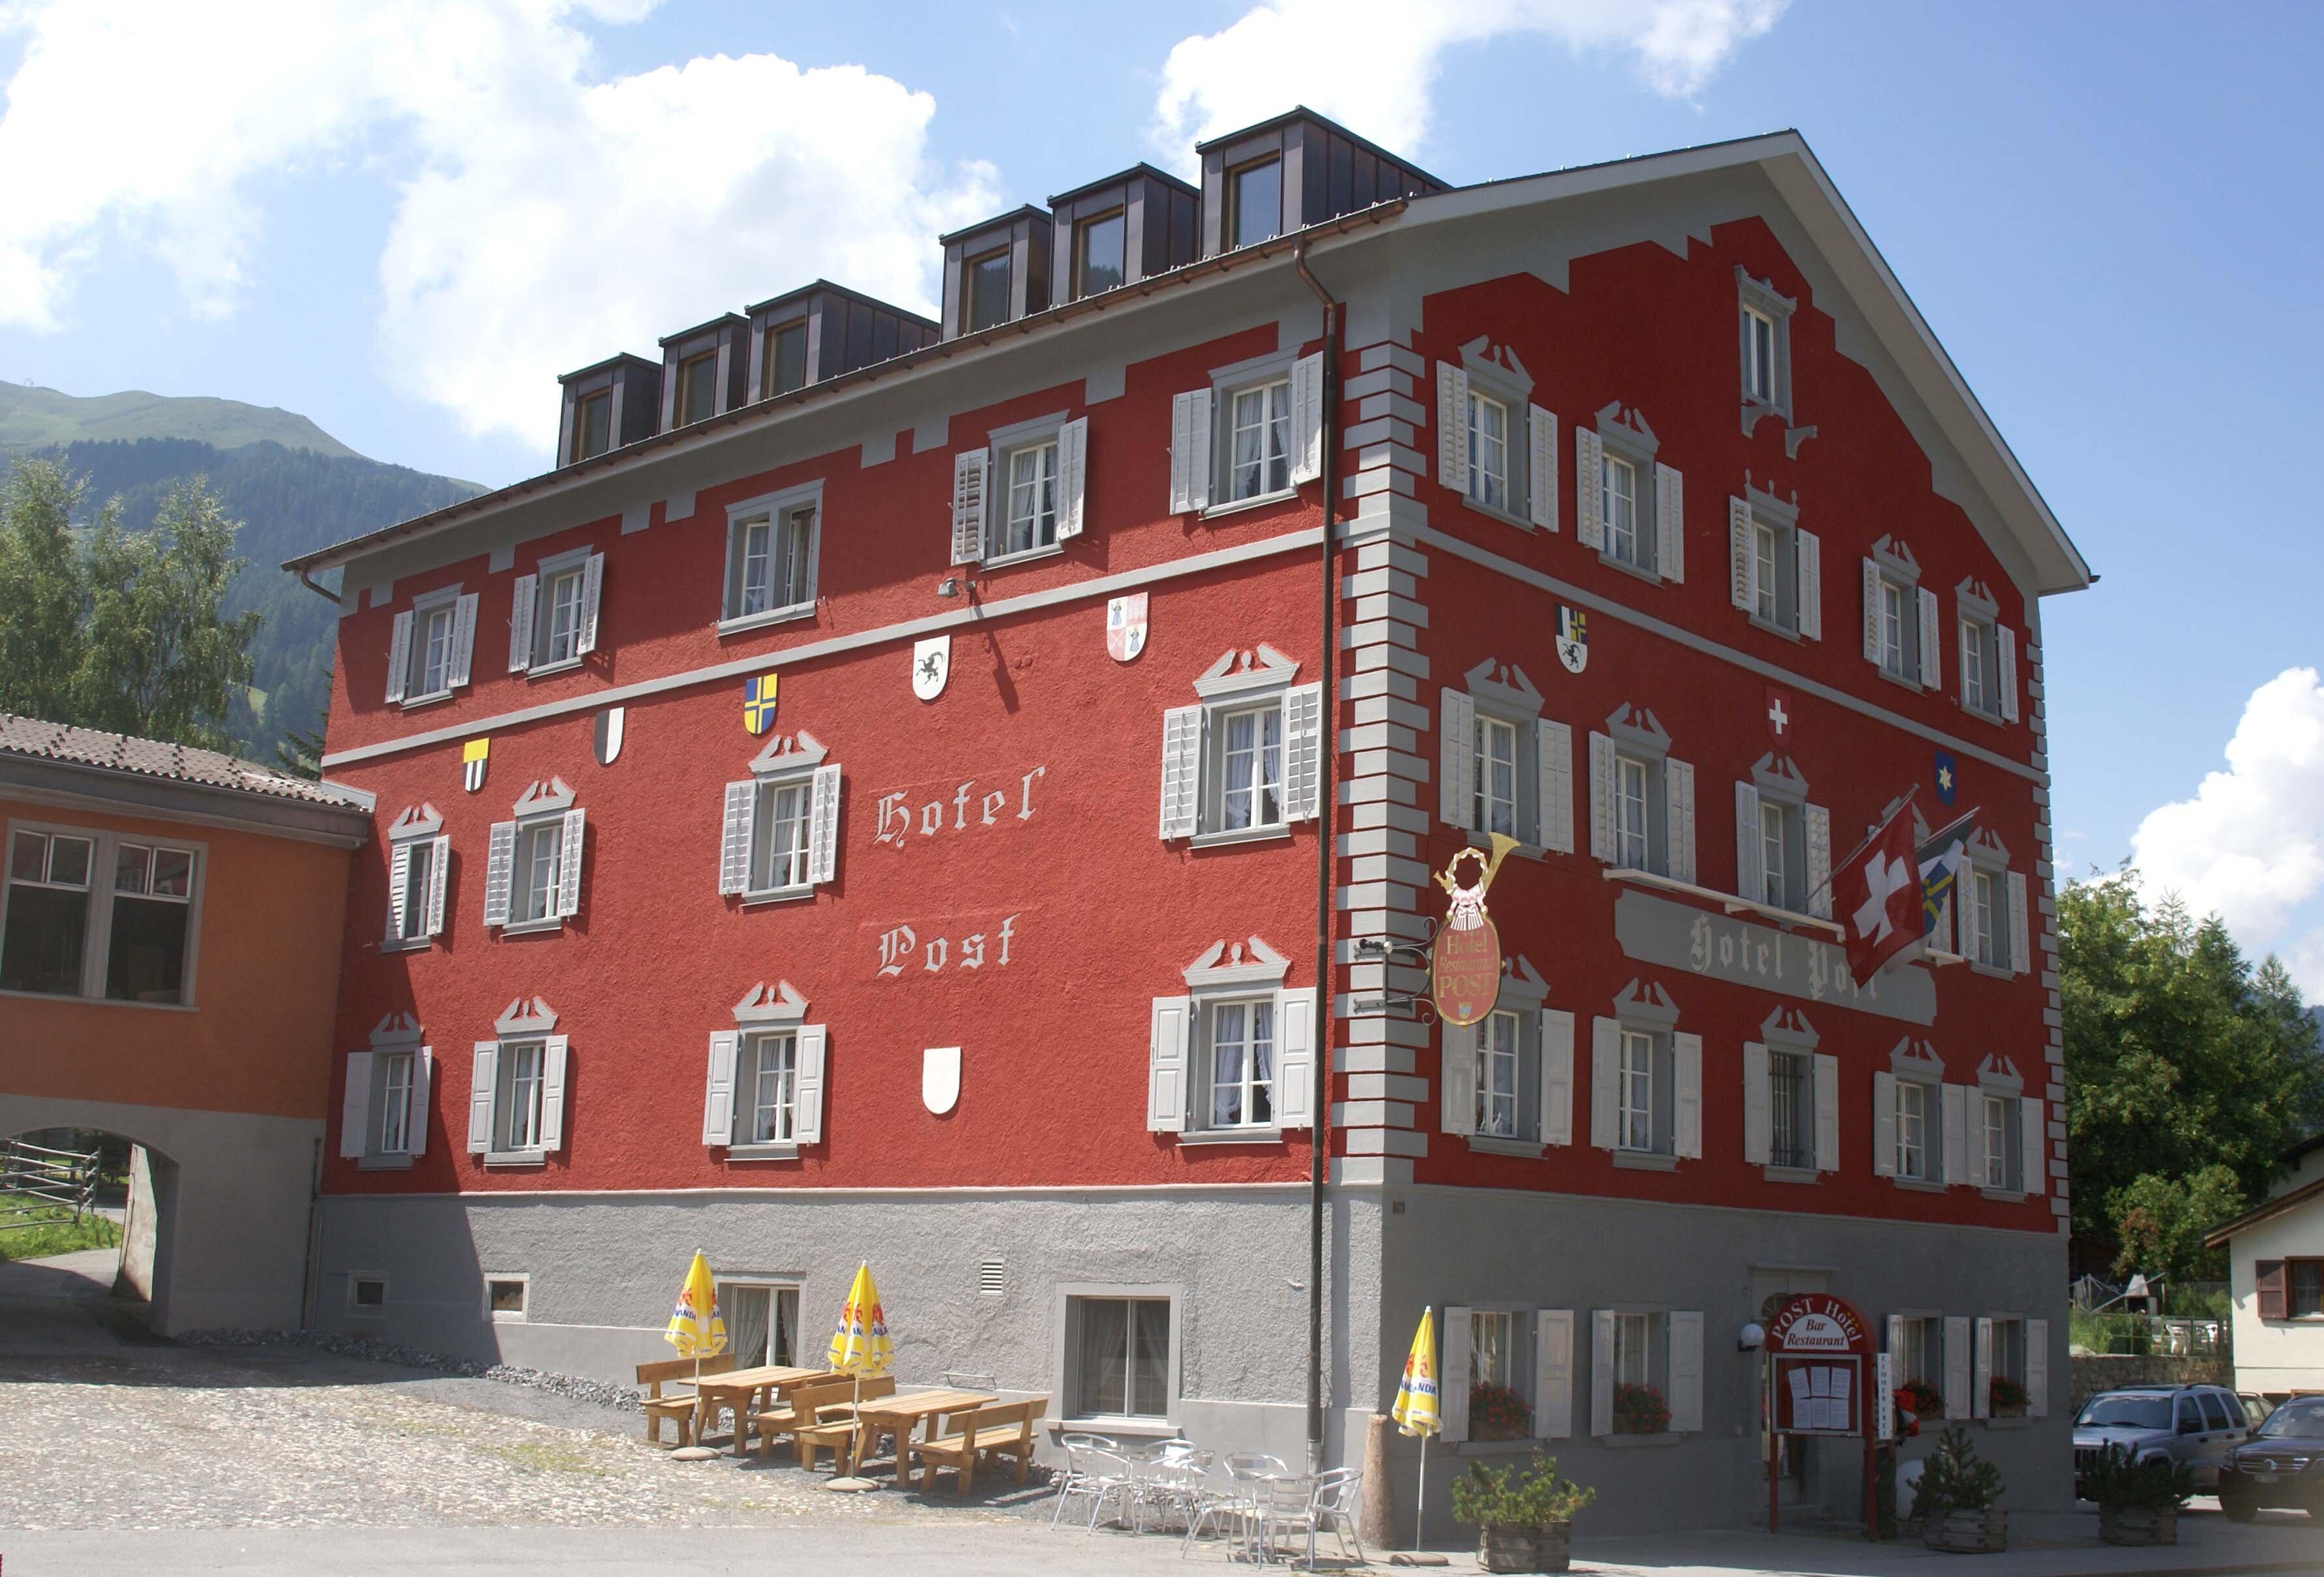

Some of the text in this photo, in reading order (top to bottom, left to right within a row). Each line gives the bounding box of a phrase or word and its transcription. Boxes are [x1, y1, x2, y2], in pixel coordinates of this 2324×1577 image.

[873, 766, 1045, 847] Hotel
[876, 912, 1021, 978] Post
[1446, 932, 1487, 954] Hotel
[1690, 912, 1783, 980] Hotel
[1438, 972, 1496, 999] POST
[1772, 1297, 1862, 1342] POST Hotel
[1805, 1319, 1826, 1331] Bar
[1787, 1333, 1845, 1346] Restaurant
